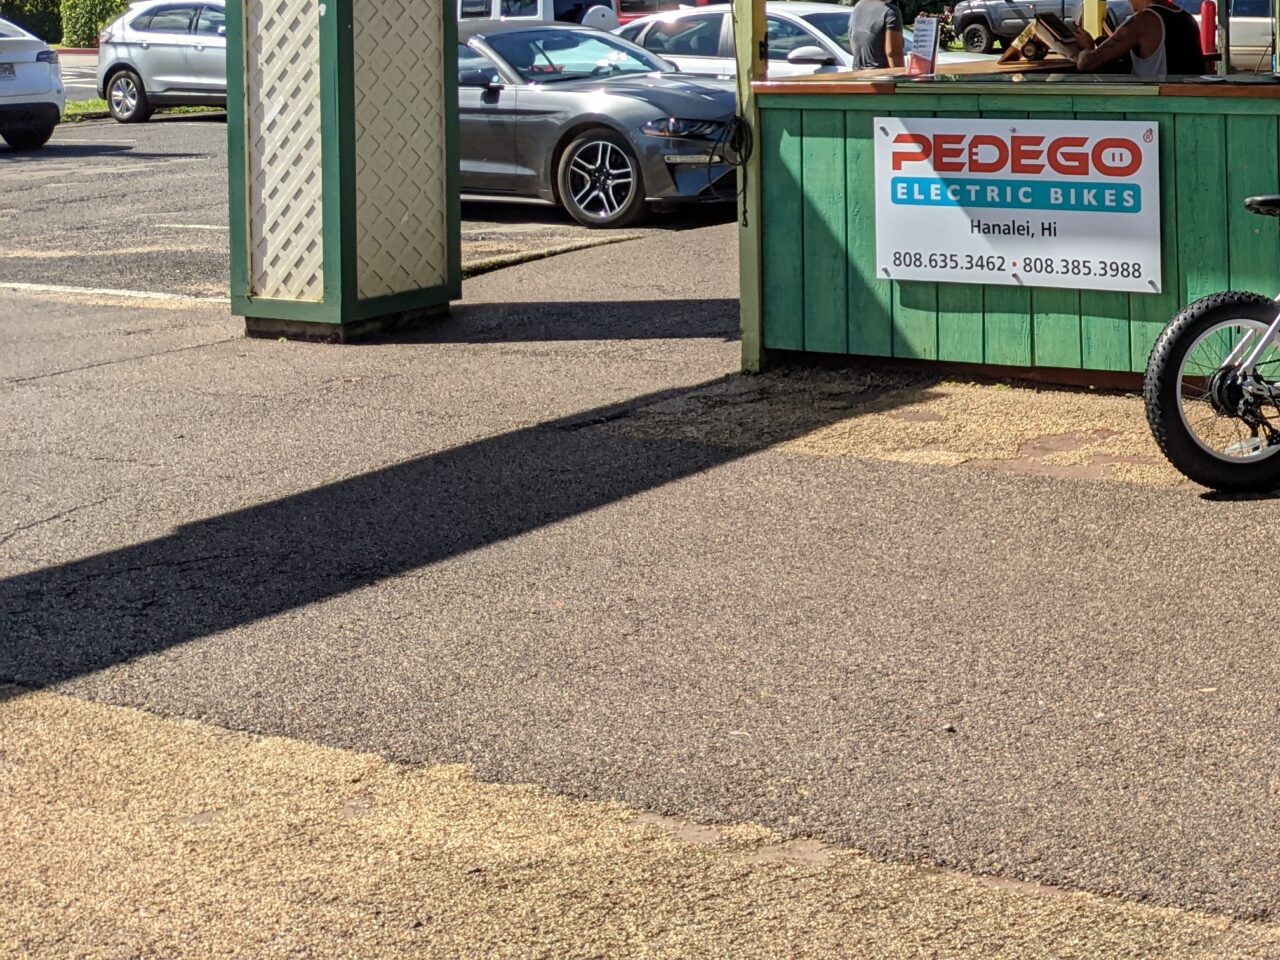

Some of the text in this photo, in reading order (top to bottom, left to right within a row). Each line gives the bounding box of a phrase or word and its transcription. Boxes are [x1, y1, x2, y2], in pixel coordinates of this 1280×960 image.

[892, 133, 1142, 177] PEDEGO
[896, 183, 1135, 207] ELECTRIC BIKES
[970, 219, 1057, 238] Hanalei, Hi
[893, 251, 1142, 279] 808.635.3462 808.385.3988
